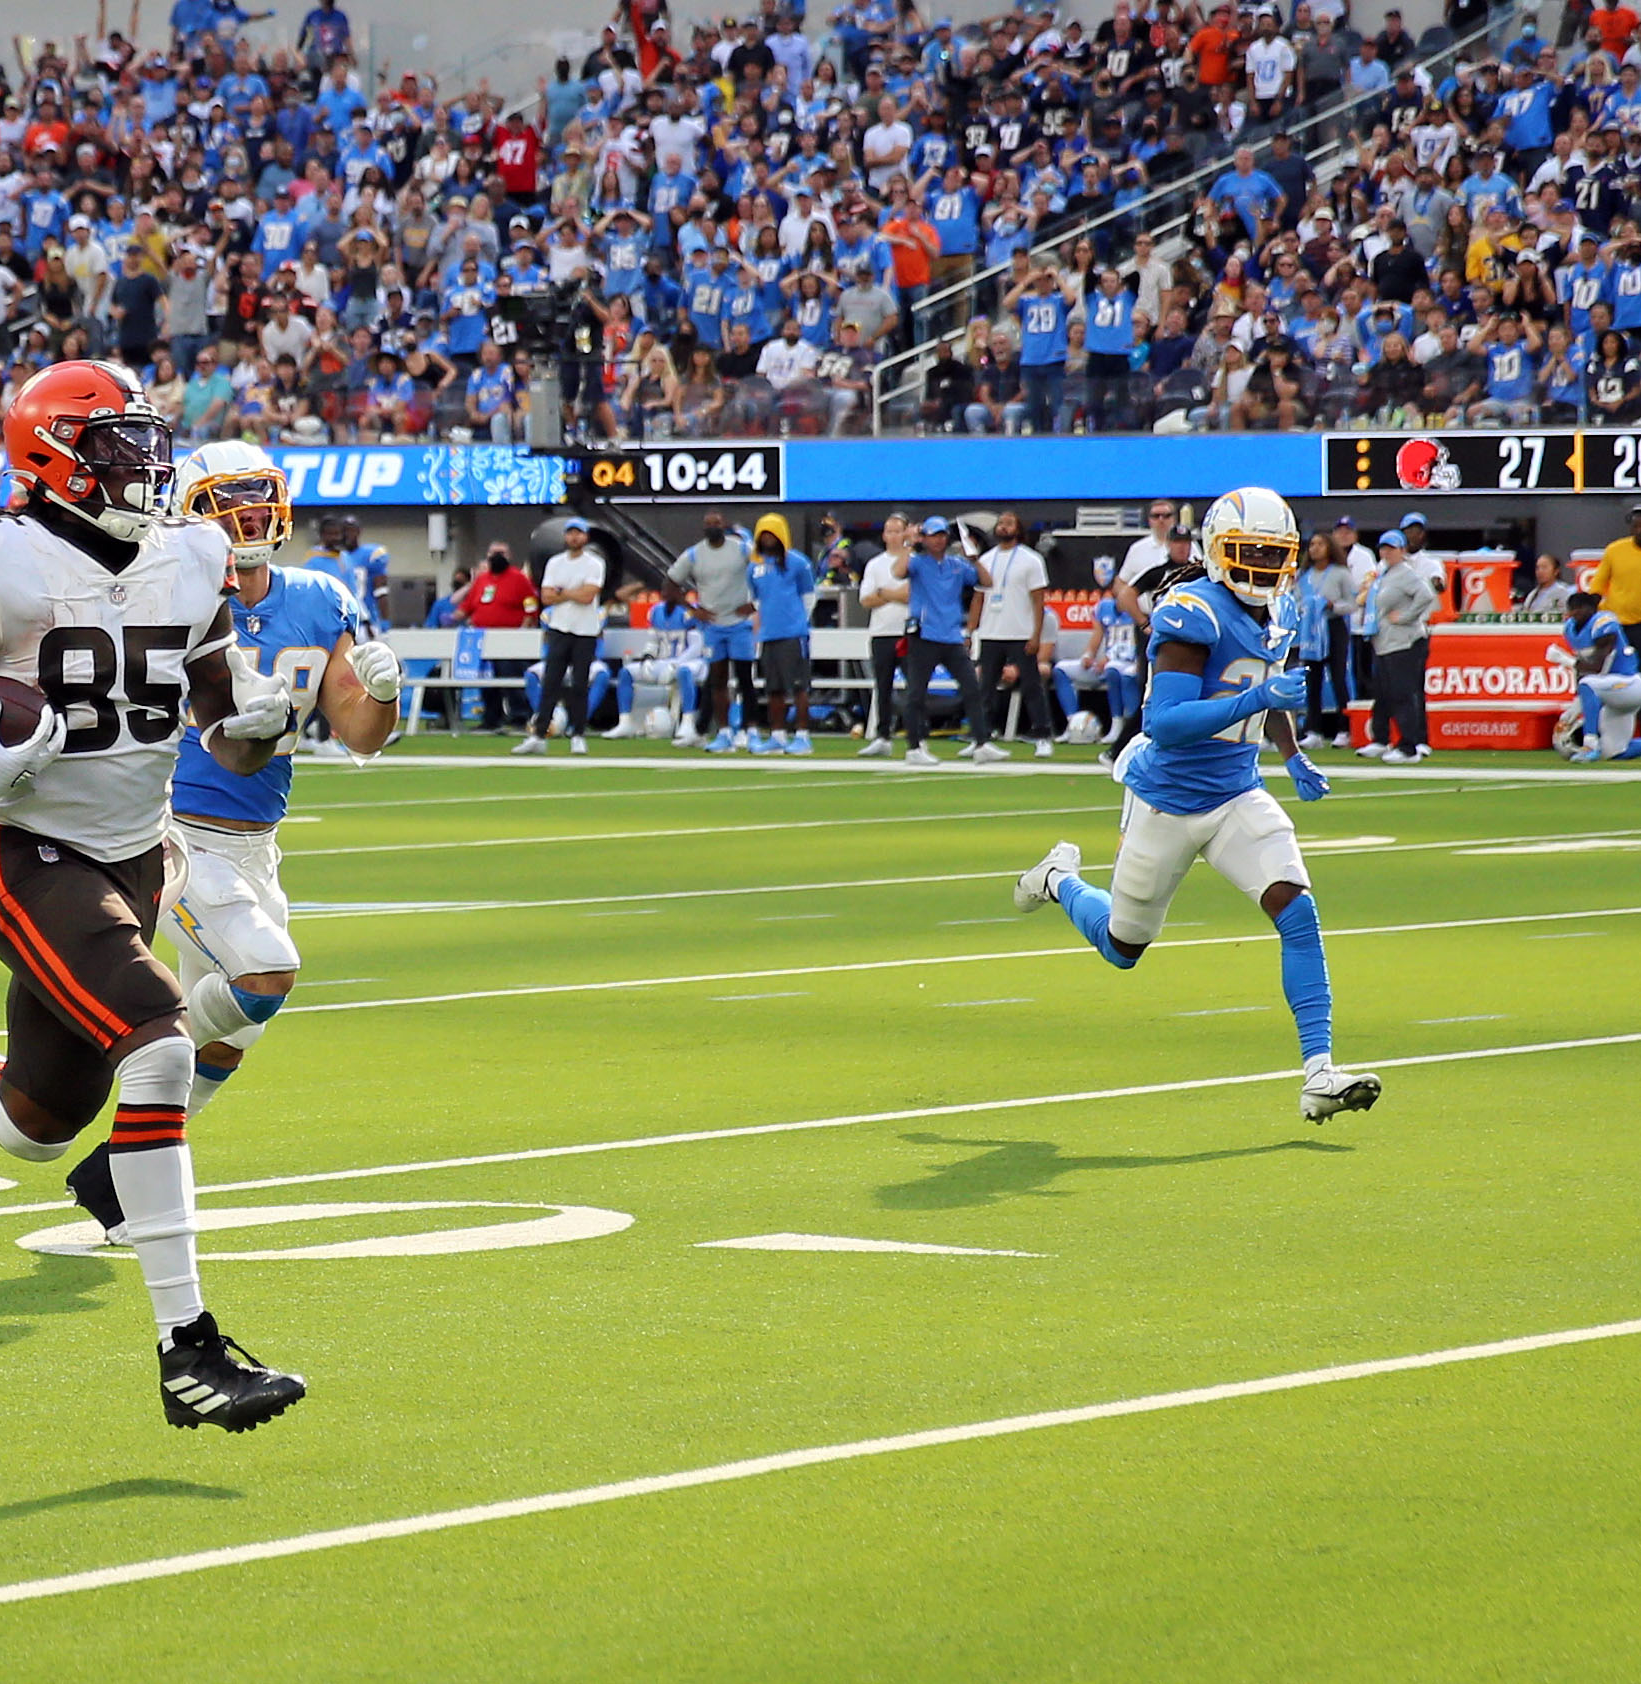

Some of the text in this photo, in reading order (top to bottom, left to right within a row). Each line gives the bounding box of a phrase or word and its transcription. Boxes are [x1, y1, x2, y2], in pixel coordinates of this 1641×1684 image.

[500, 140, 527, 164] 47
[1575, 180, 1599, 209] 21
[693, 285, 721, 313] 21
[1572, 279, 1600, 309] 10
[1493, 350, 1521, 381] 10
[282, 453, 404, 498] TUP
[592, 461, 635, 487] Q4
[644, 452, 767, 491] 10:44
[1499, 436, 1546, 488] 27
[1613, 436, 1641, 488] 2
[38, 625, 191, 754] 85
[1210, 657, 1286, 746] 2
[1441, 722, 1519, 736] GATORADE
